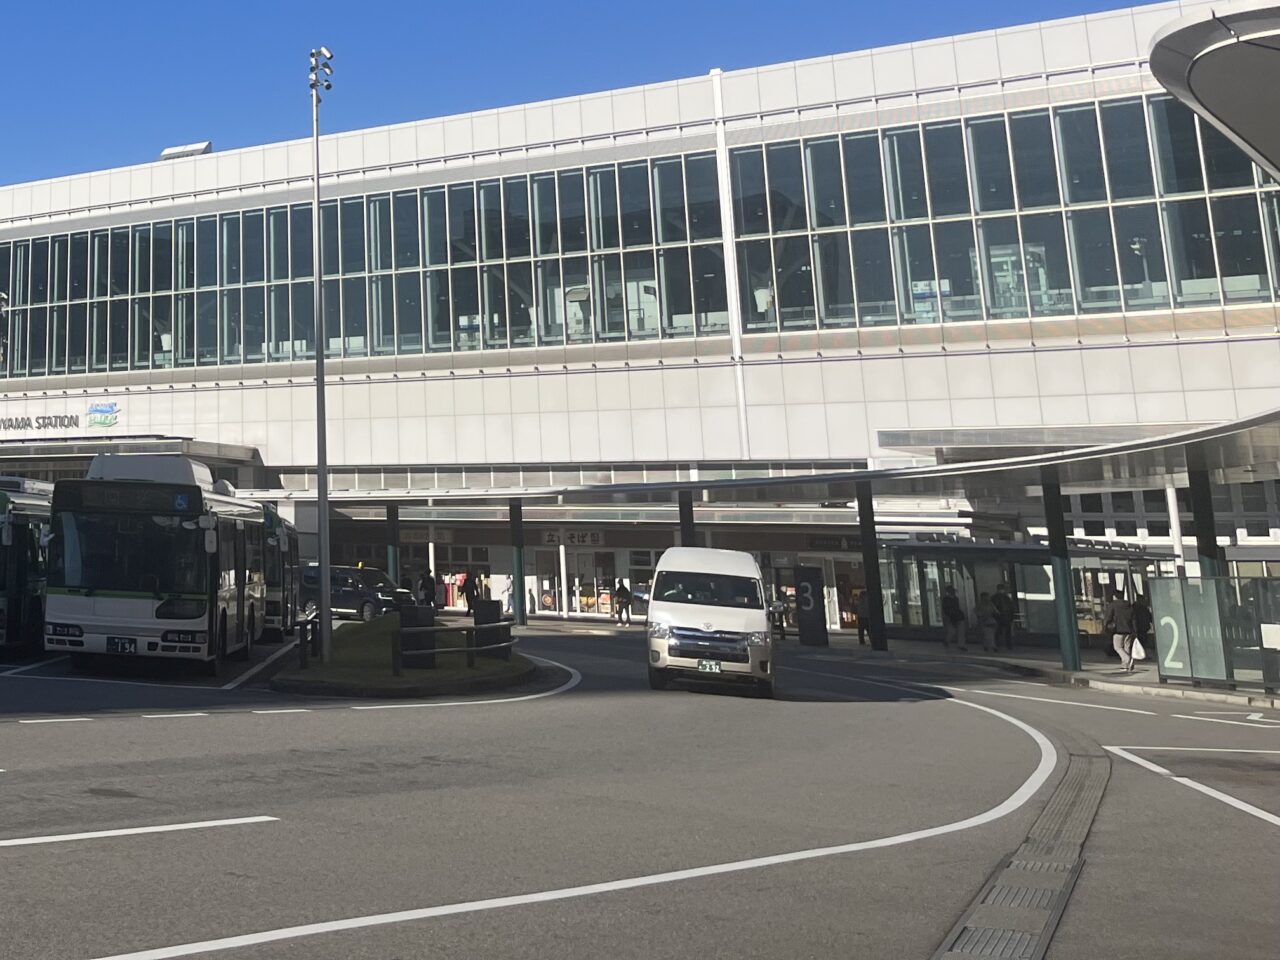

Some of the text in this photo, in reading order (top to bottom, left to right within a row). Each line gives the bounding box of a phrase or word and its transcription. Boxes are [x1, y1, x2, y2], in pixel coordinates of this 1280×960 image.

[35, 415, 80, 430] STATION
[800, 582, 814, 610] 3
[1160, 616, 1183, 669] 2
